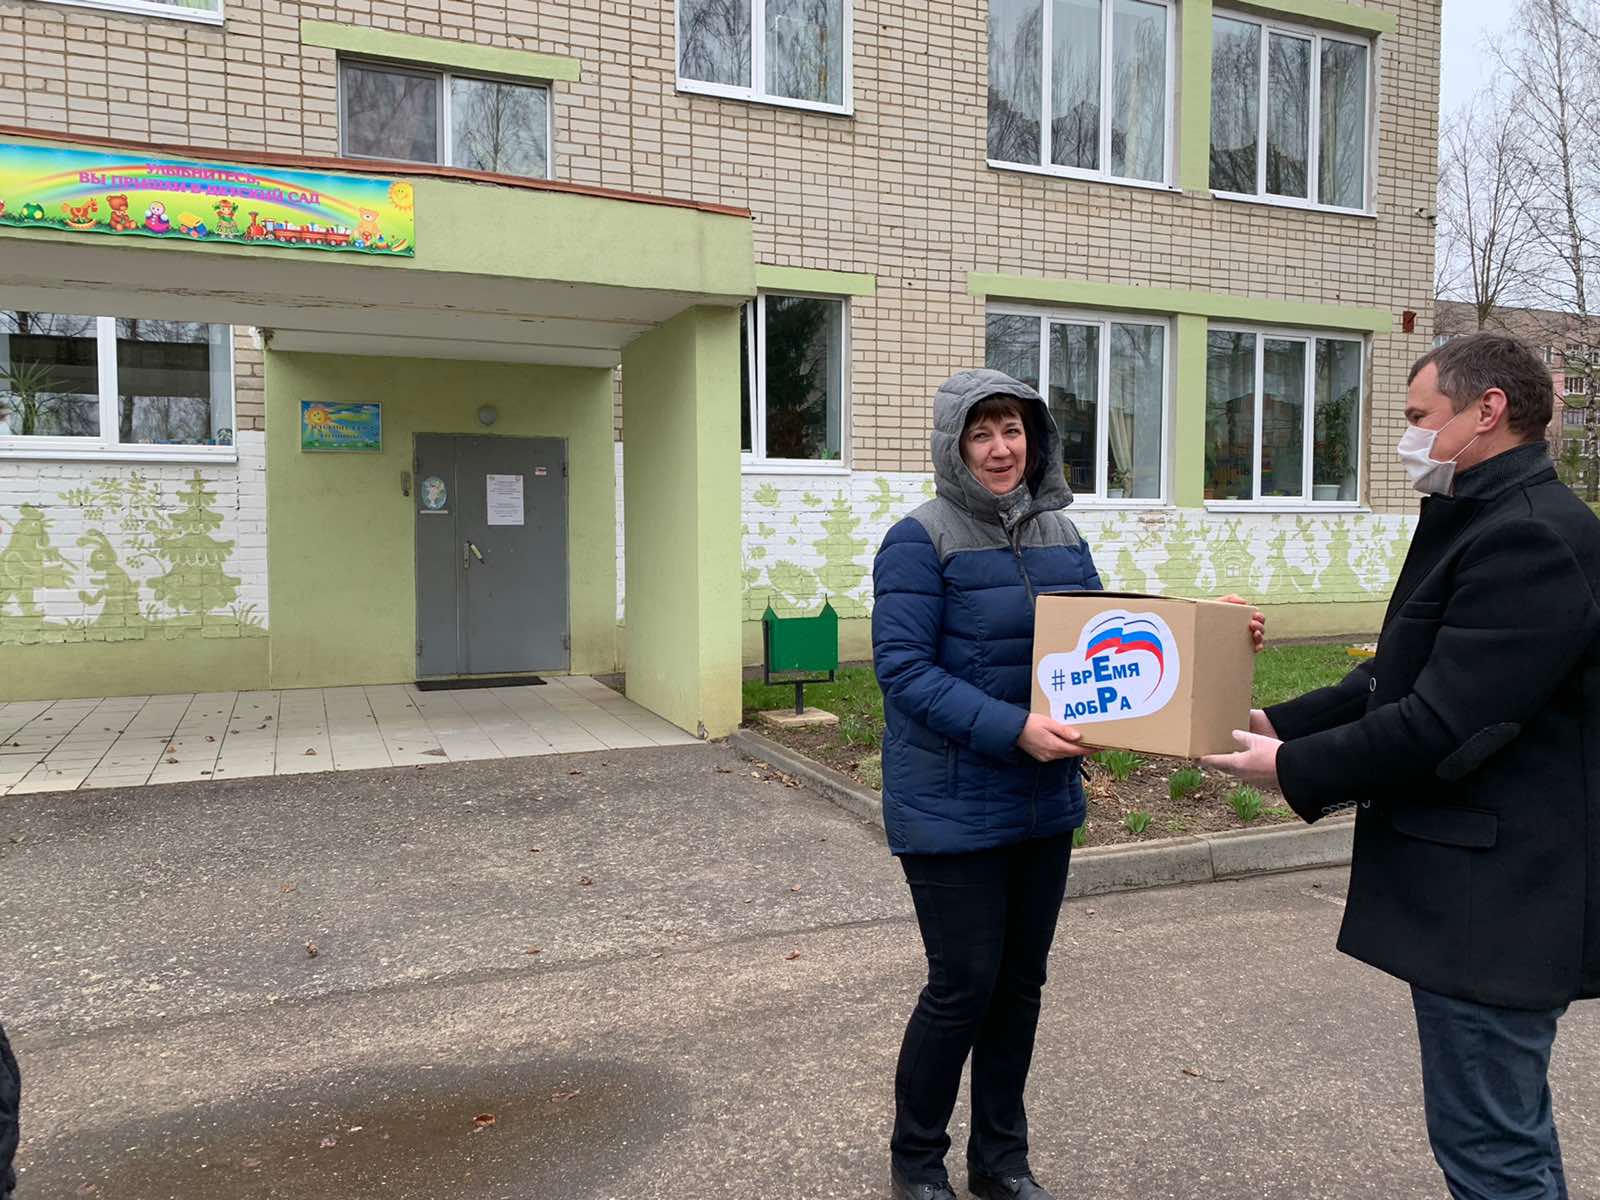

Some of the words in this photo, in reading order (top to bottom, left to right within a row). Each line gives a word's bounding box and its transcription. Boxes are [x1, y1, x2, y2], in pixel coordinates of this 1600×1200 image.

[145, 163, 260, 185] УЛЫБНИТЕСЬ,
[79, 171, 107, 185] ВЫ
[111, 175, 187, 193] ПРИШЛИ
[206, 184, 284, 202] ДЕТСКИЙ
[287, 191, 321, 206] САД
